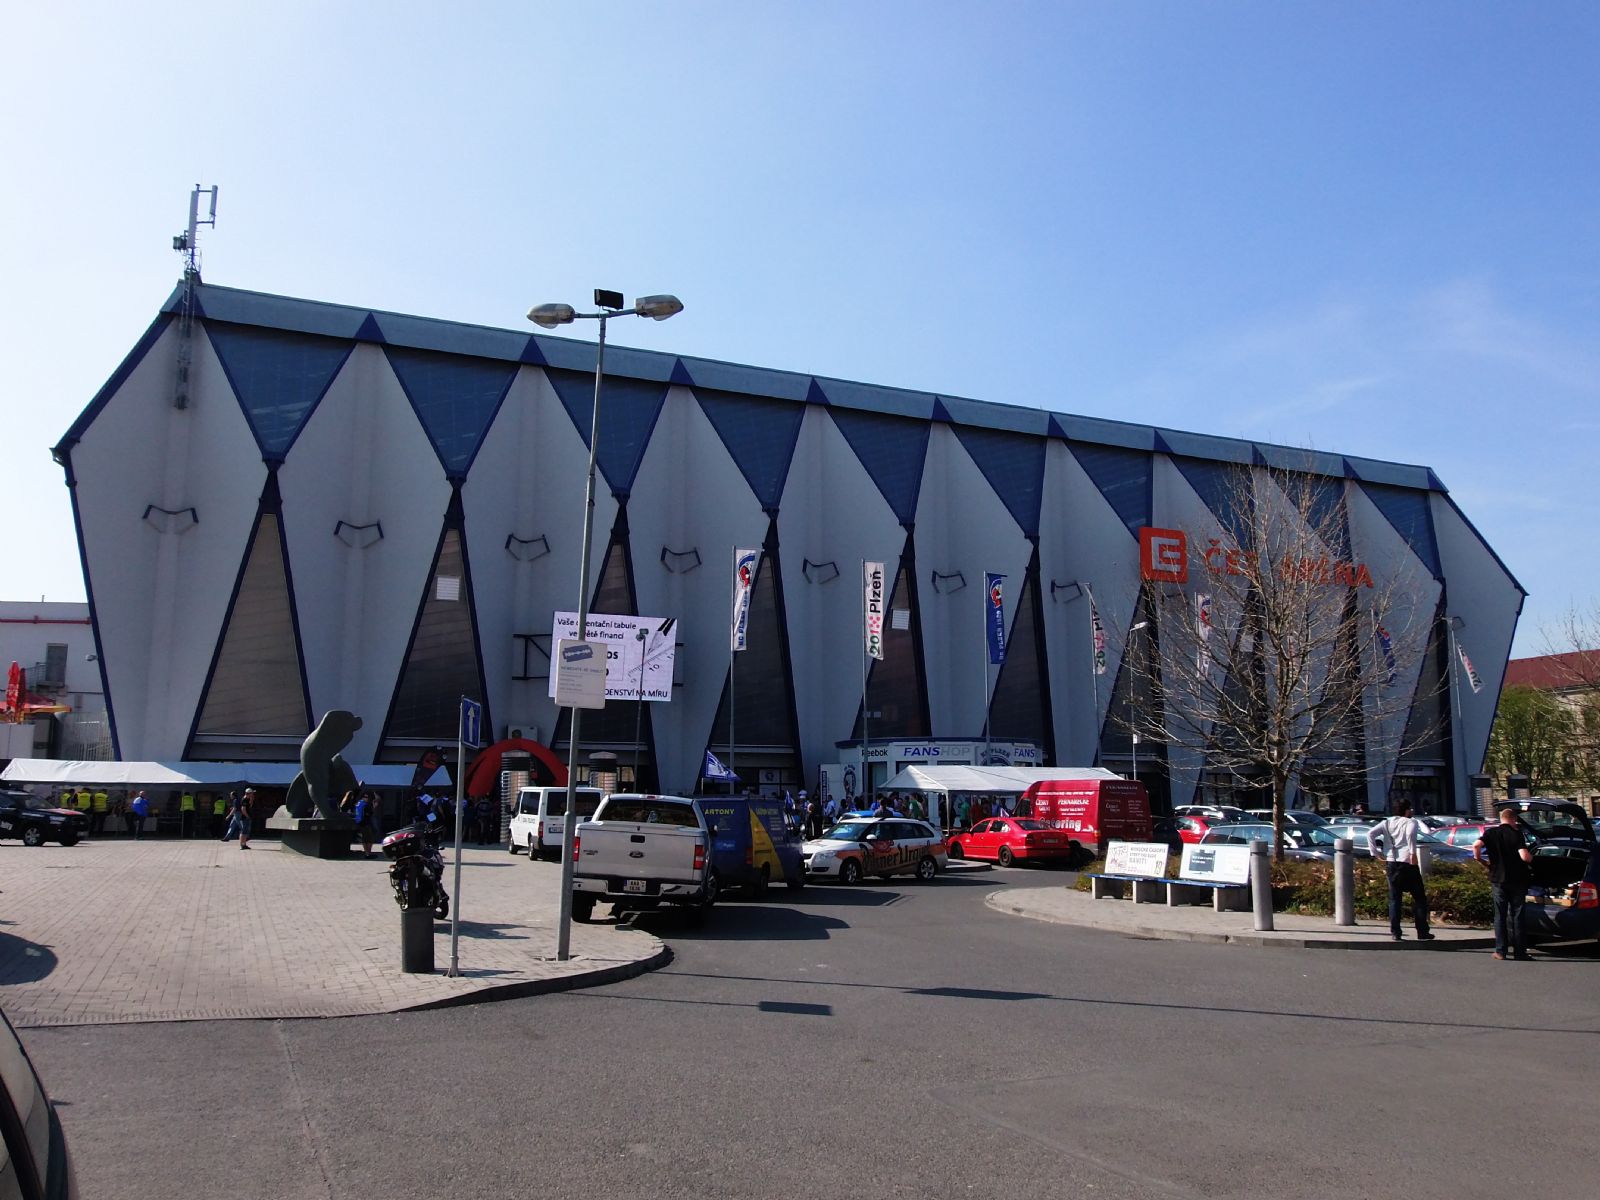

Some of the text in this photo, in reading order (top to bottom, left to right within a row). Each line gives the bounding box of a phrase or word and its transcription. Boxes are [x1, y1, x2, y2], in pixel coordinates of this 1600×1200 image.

[869, 570, 882, 614] Plzeň
[557, 617, 575, 626] Vaše
[599, 632, 624, 640] financí
[647, 689, 668, 698] MÍRU
